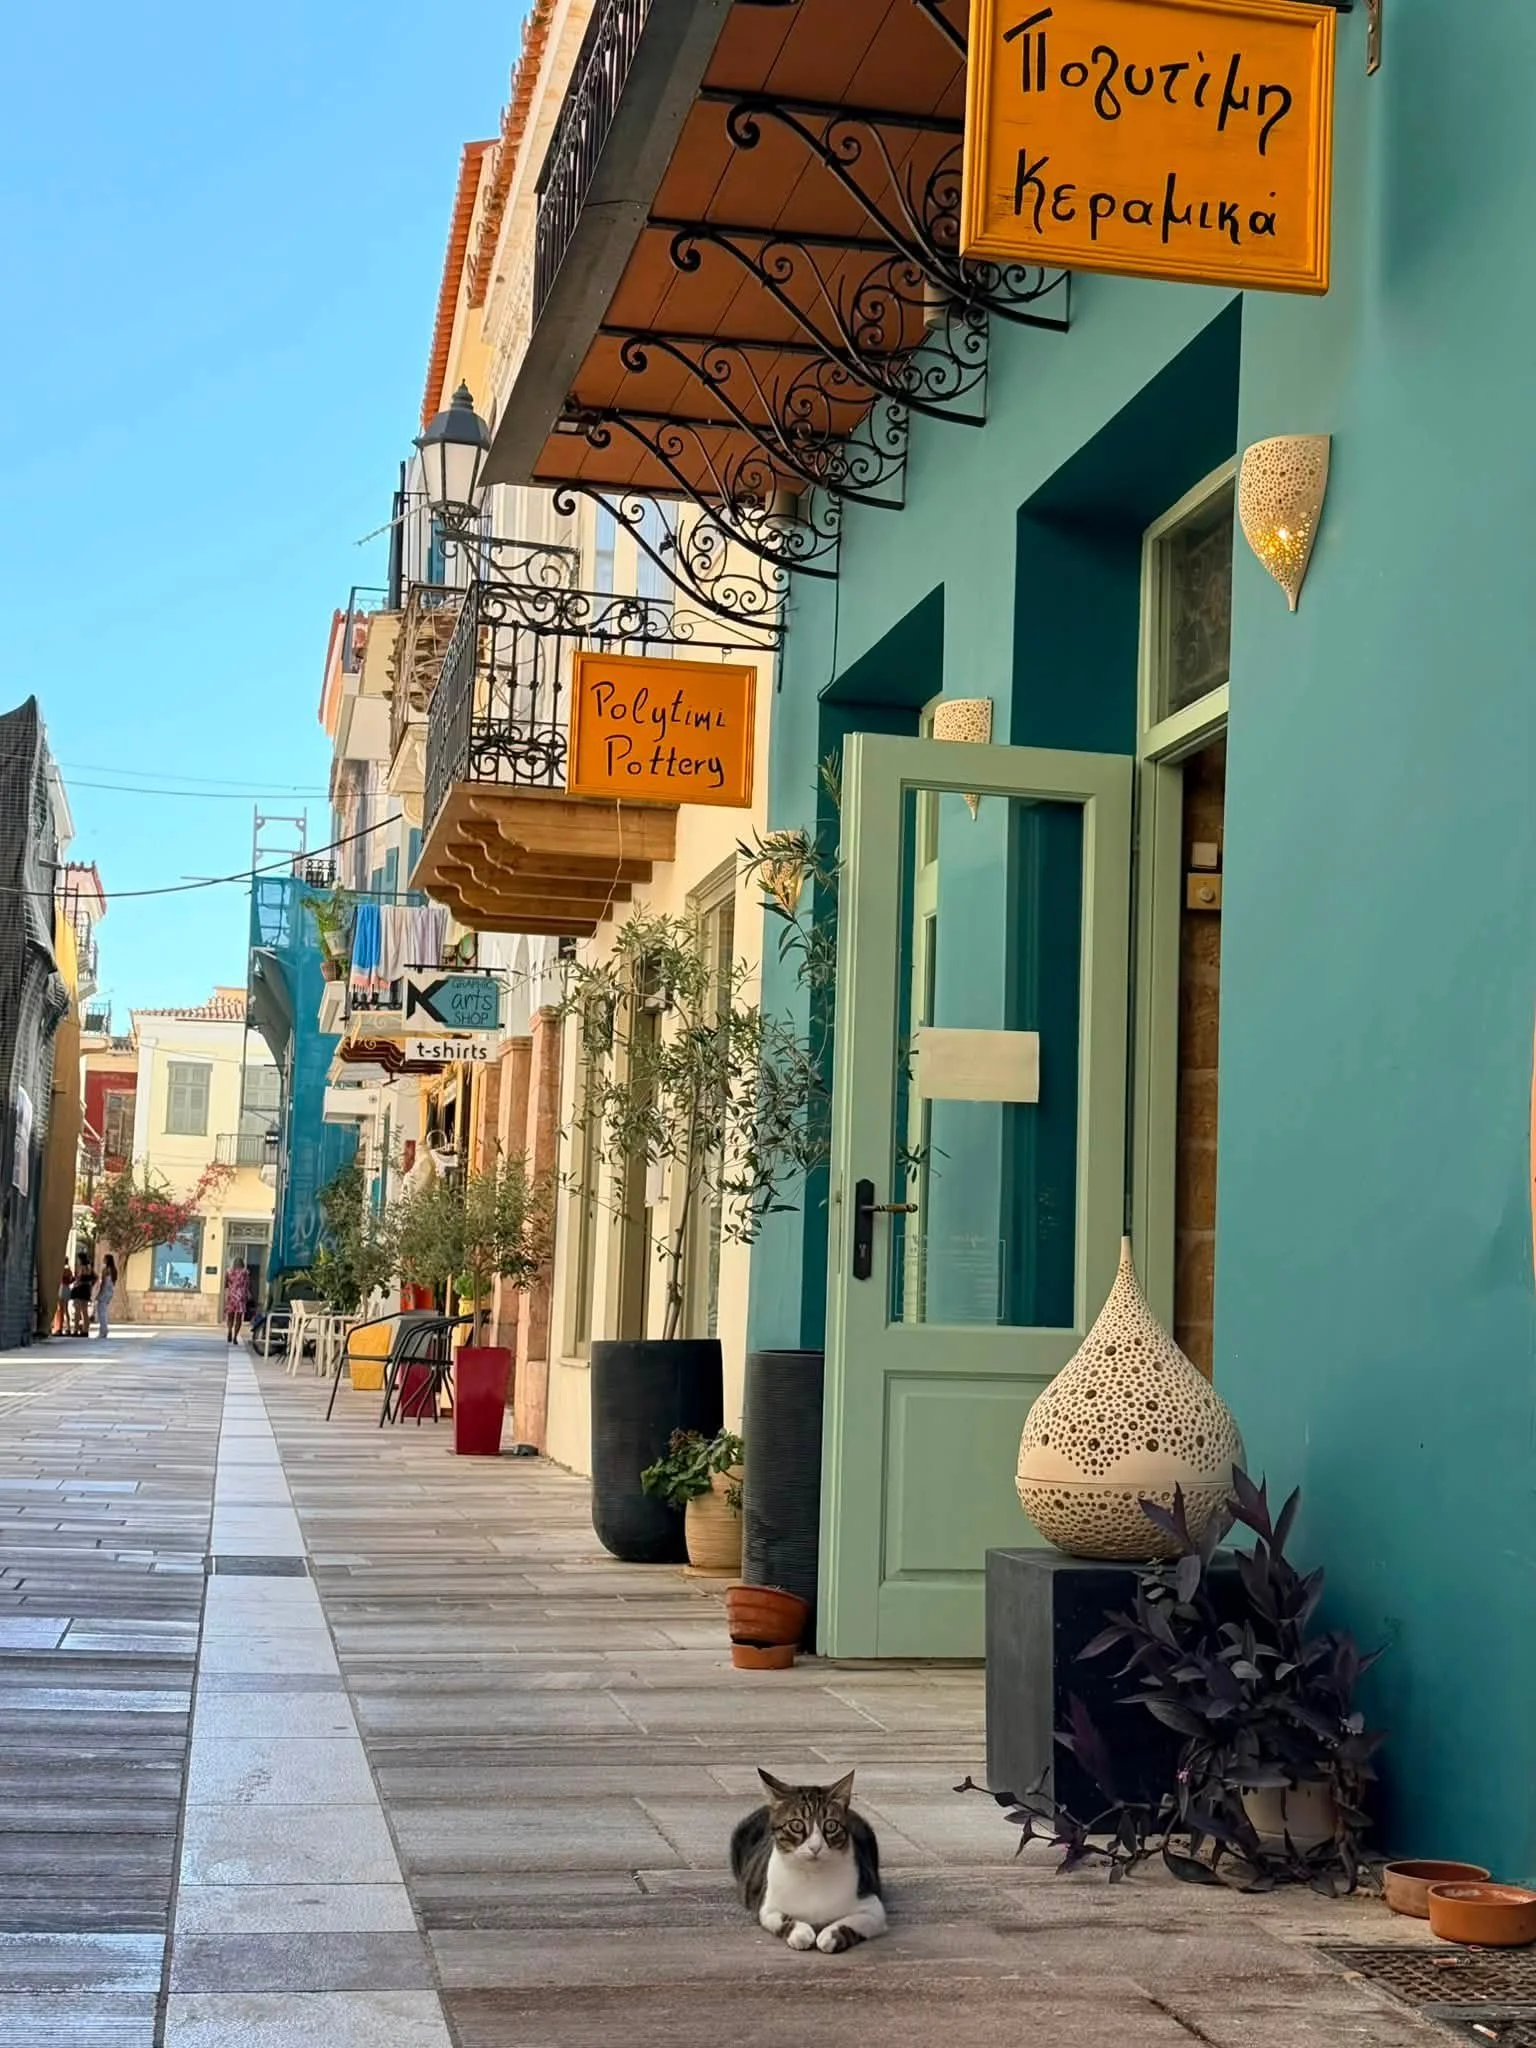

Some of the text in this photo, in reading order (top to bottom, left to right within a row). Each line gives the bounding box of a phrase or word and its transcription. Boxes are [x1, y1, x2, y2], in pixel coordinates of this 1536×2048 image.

[1002, 7, 1293, 156] Πολυτίμη
[1013, 148, 1277, 246] Κεραμικά
[590, 680, 726, 743] Polytimi
[603, 734, 725, 789] Pottery
[451, 988, 493, 1011] arts
[454, 1010, 489, 1025] SHOP
[416, 1041, 488, 1060] t-shirts
